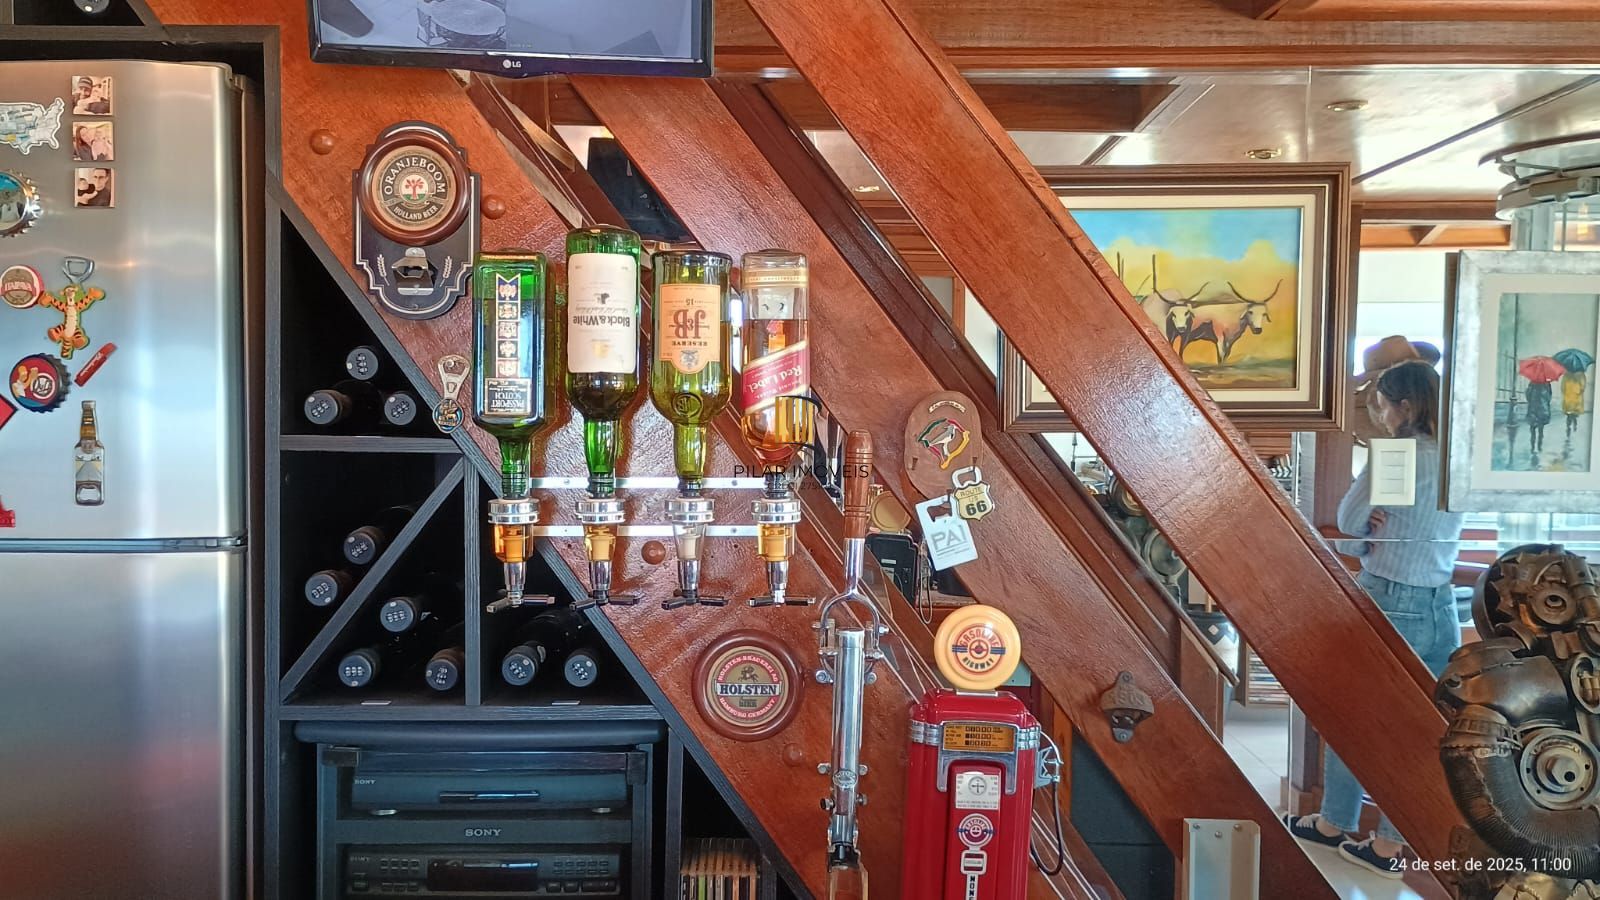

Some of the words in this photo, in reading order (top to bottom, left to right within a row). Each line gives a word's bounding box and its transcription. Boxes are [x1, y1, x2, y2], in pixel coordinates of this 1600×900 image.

[384, 157, 446, 195] ORANJEBOOM
[394, 206, 422, 220] HOLLAND
[423, 205, 439, 218] BEER
[685, 298, 694, 306] 15
[572, 315, 599, 326] White
[607, 316, 630, 327] Black
[779, 364, 803, 381] Red
[746, 374, 778, 394] Label
[494, 391, 521, 400] SCOTCH
[490, 400, 525, 408] PASSPORT
[960, 486, 983, 497] ROUTE
[966, 500, 987, 516] 66
[931, 524, 967, 550] PAI
[960, 628, 999, 647] GASOLINE
[720, 684, 777, 695] HOLSTEN
[465, 828, 502, 837] SONY
